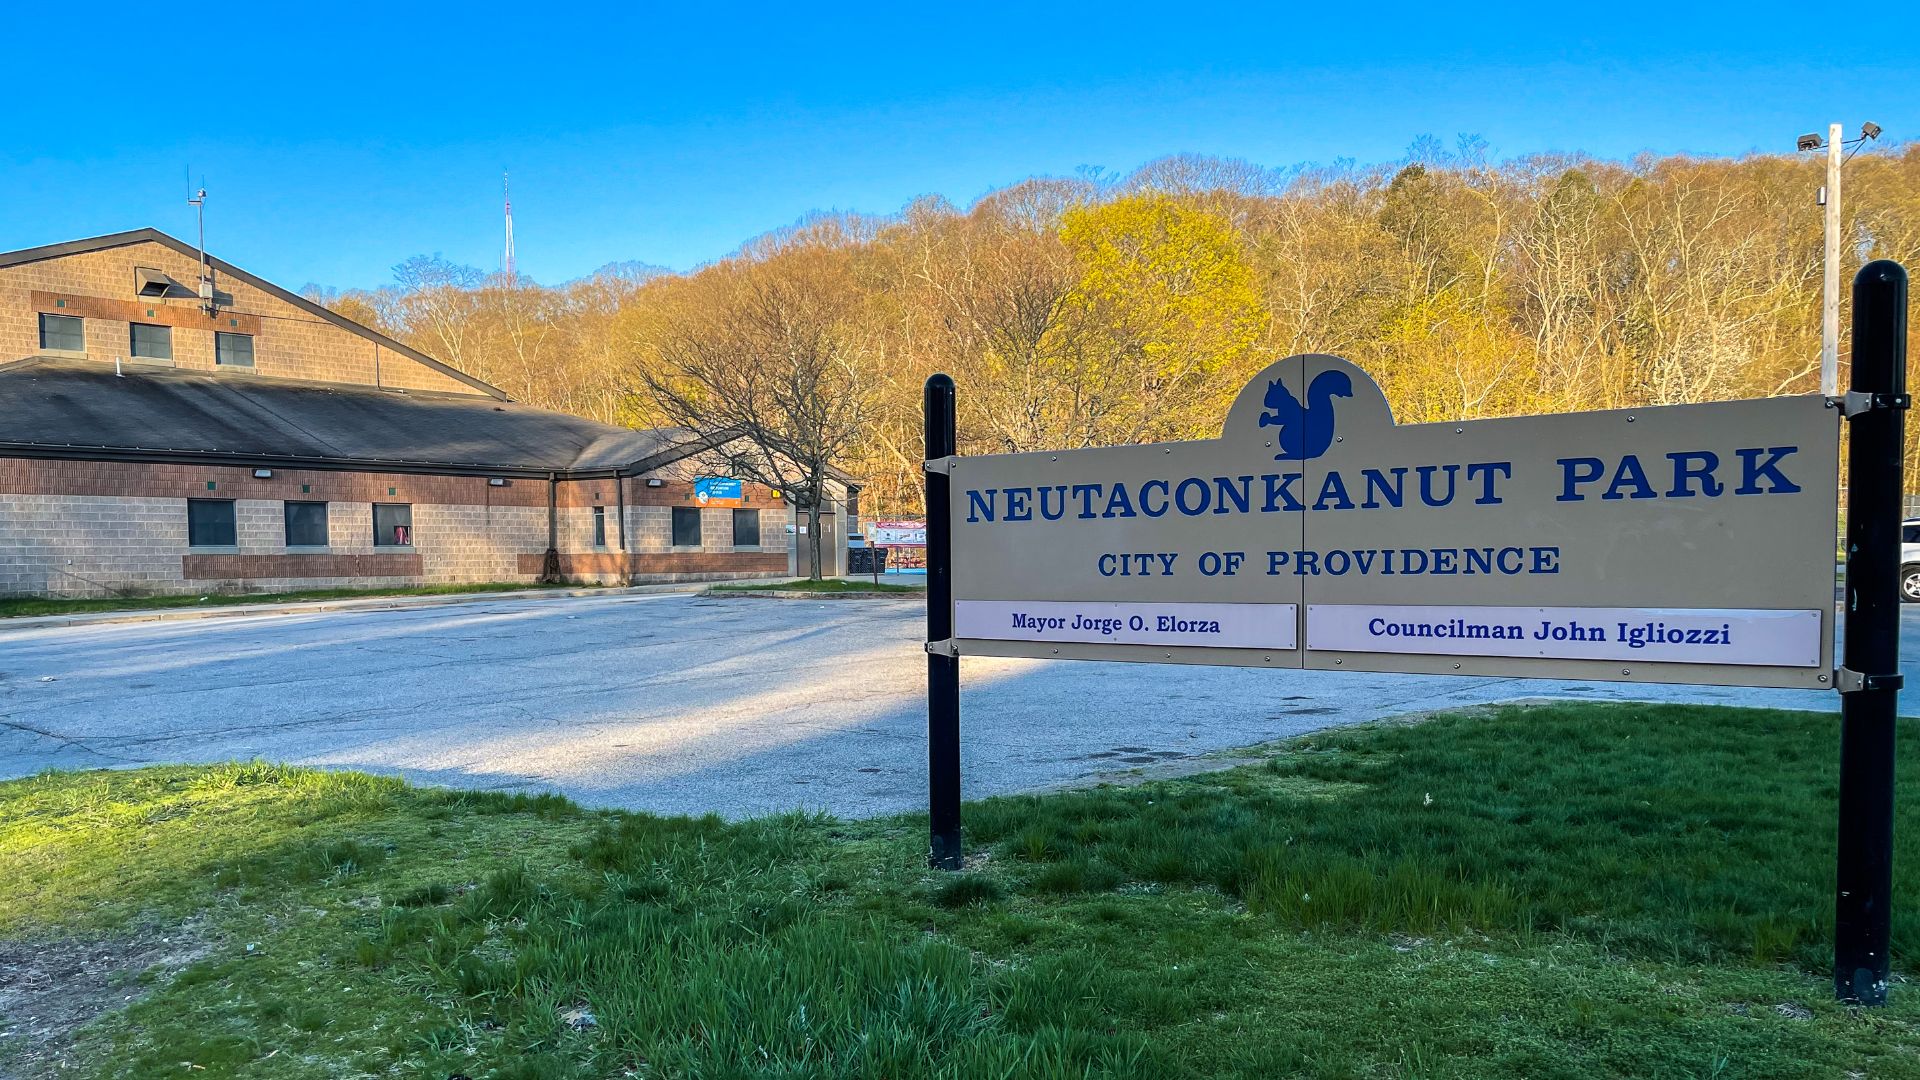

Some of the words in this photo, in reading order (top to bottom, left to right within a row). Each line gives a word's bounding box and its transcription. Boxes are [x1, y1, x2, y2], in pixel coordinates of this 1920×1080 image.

[966, 461, 1512, 523] NEUTACONKANUT
[1556, 446, 1802, 502] PARK
[1098, 553, 1177, 576] CITY
[1199, 552, 1245, 576] OF
[1266, 546, 1560, 577] PROVIDENCE
[1012, 613, 1065, 633] Mayor
[1071, 615, 1122, 635] Jorge
[1129, 616, 1148, 631] O.
[1157, 616, 1220, 633] Elorza
[1369, 618, 1524, 639] Councilman
[1534, 621, 1606, 641] John
[1617, 623, 1731, 648] Igliozzi
